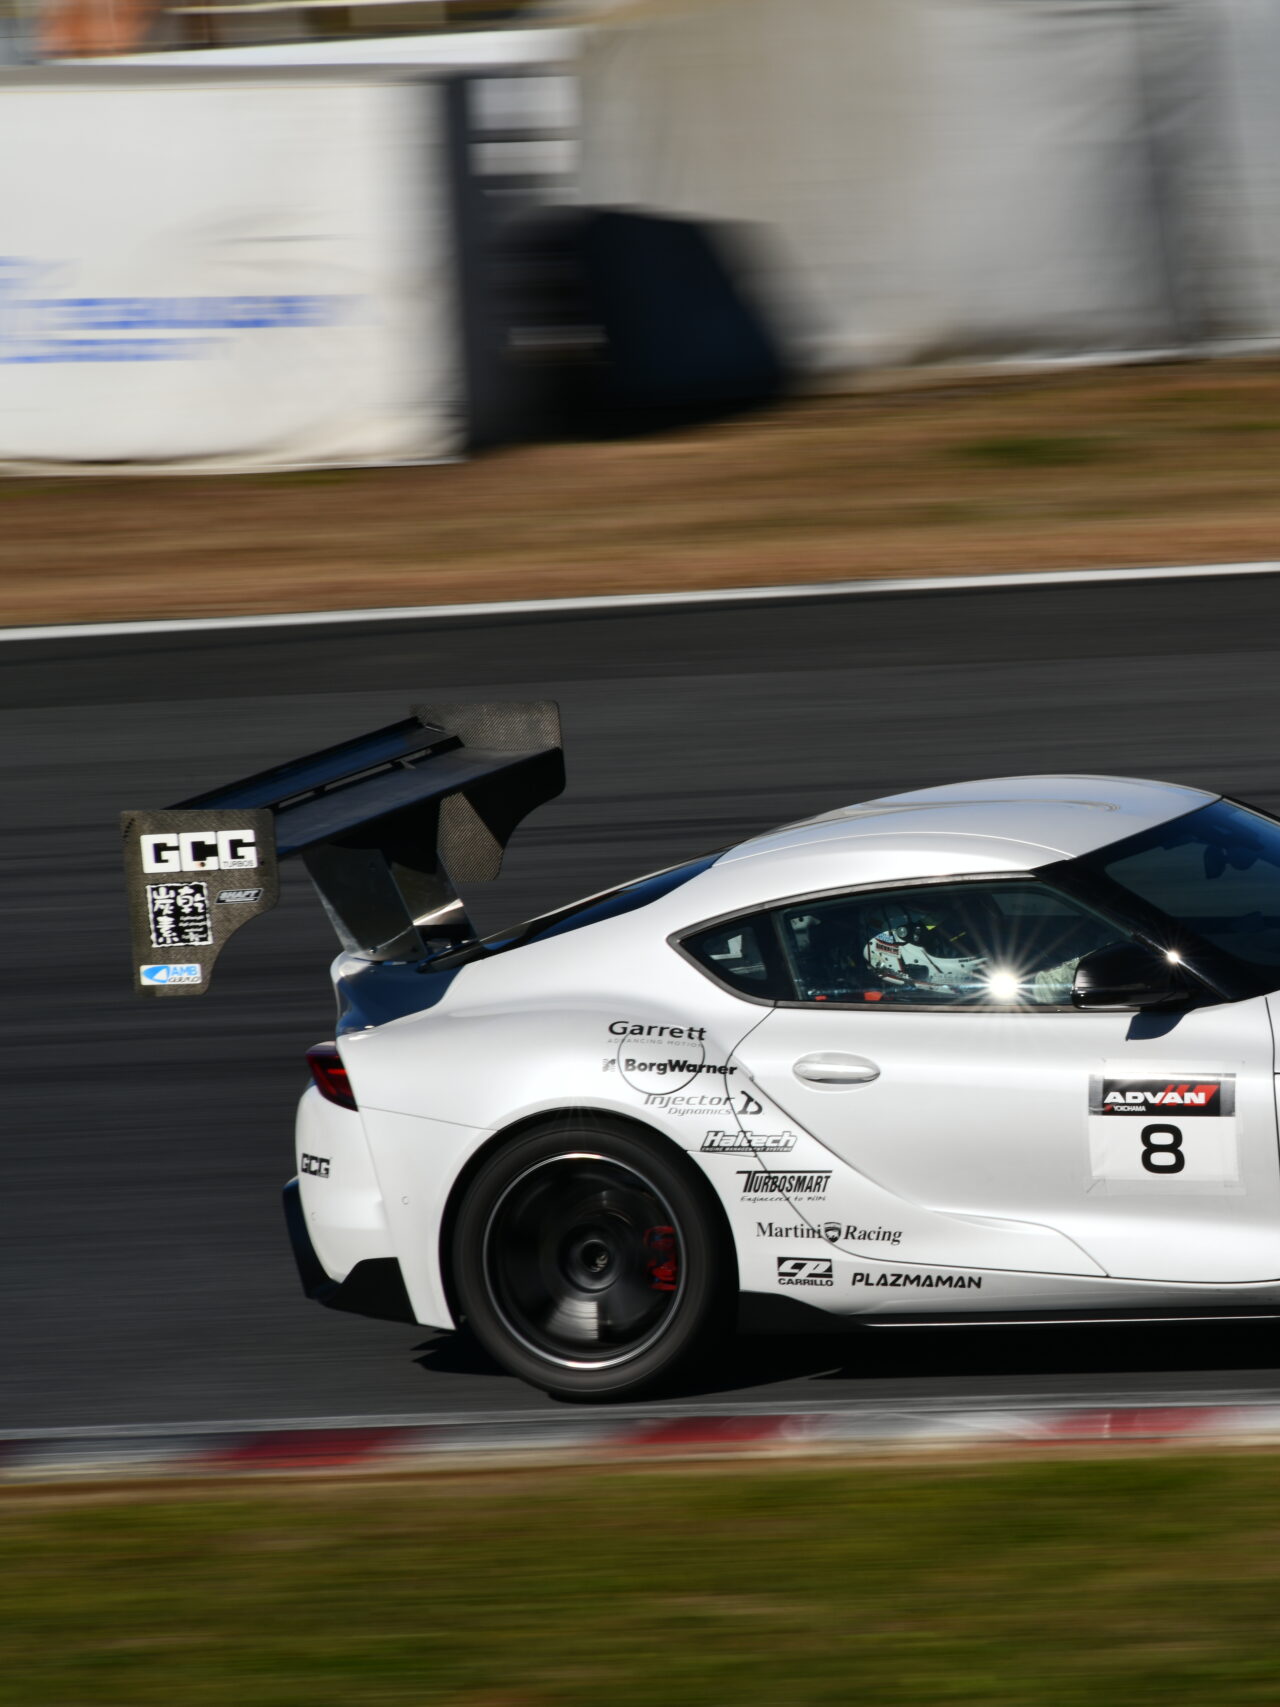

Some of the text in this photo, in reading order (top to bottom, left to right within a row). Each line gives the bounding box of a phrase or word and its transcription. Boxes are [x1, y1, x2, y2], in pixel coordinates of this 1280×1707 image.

[140, 830, 258, 873] GCG
[171, 966, 198, 976] AMB
[608, 1021, 706, 1040] Garrett
[624, 1058, 738, 1075] BorgWarner
[644, 1094, 735, 1108] Injector
[1103, 1092, 1206, 1104] ADVAN
[668, 1107, 733, 1116] Dynamics
[702, 1131, 798, 1147] Haltech
[1141, 1123, 1185, 1174] 8
[301, 1153, 330, 1178] GCG
[736, 1170, 832, 1193] TURBOSMART
[756, 1222, 902, 1245] Martini Racing
[778, 1278, 834, 1287] CARRILLO
[851, 1273, 982, 1289] PLAZMAMAN
